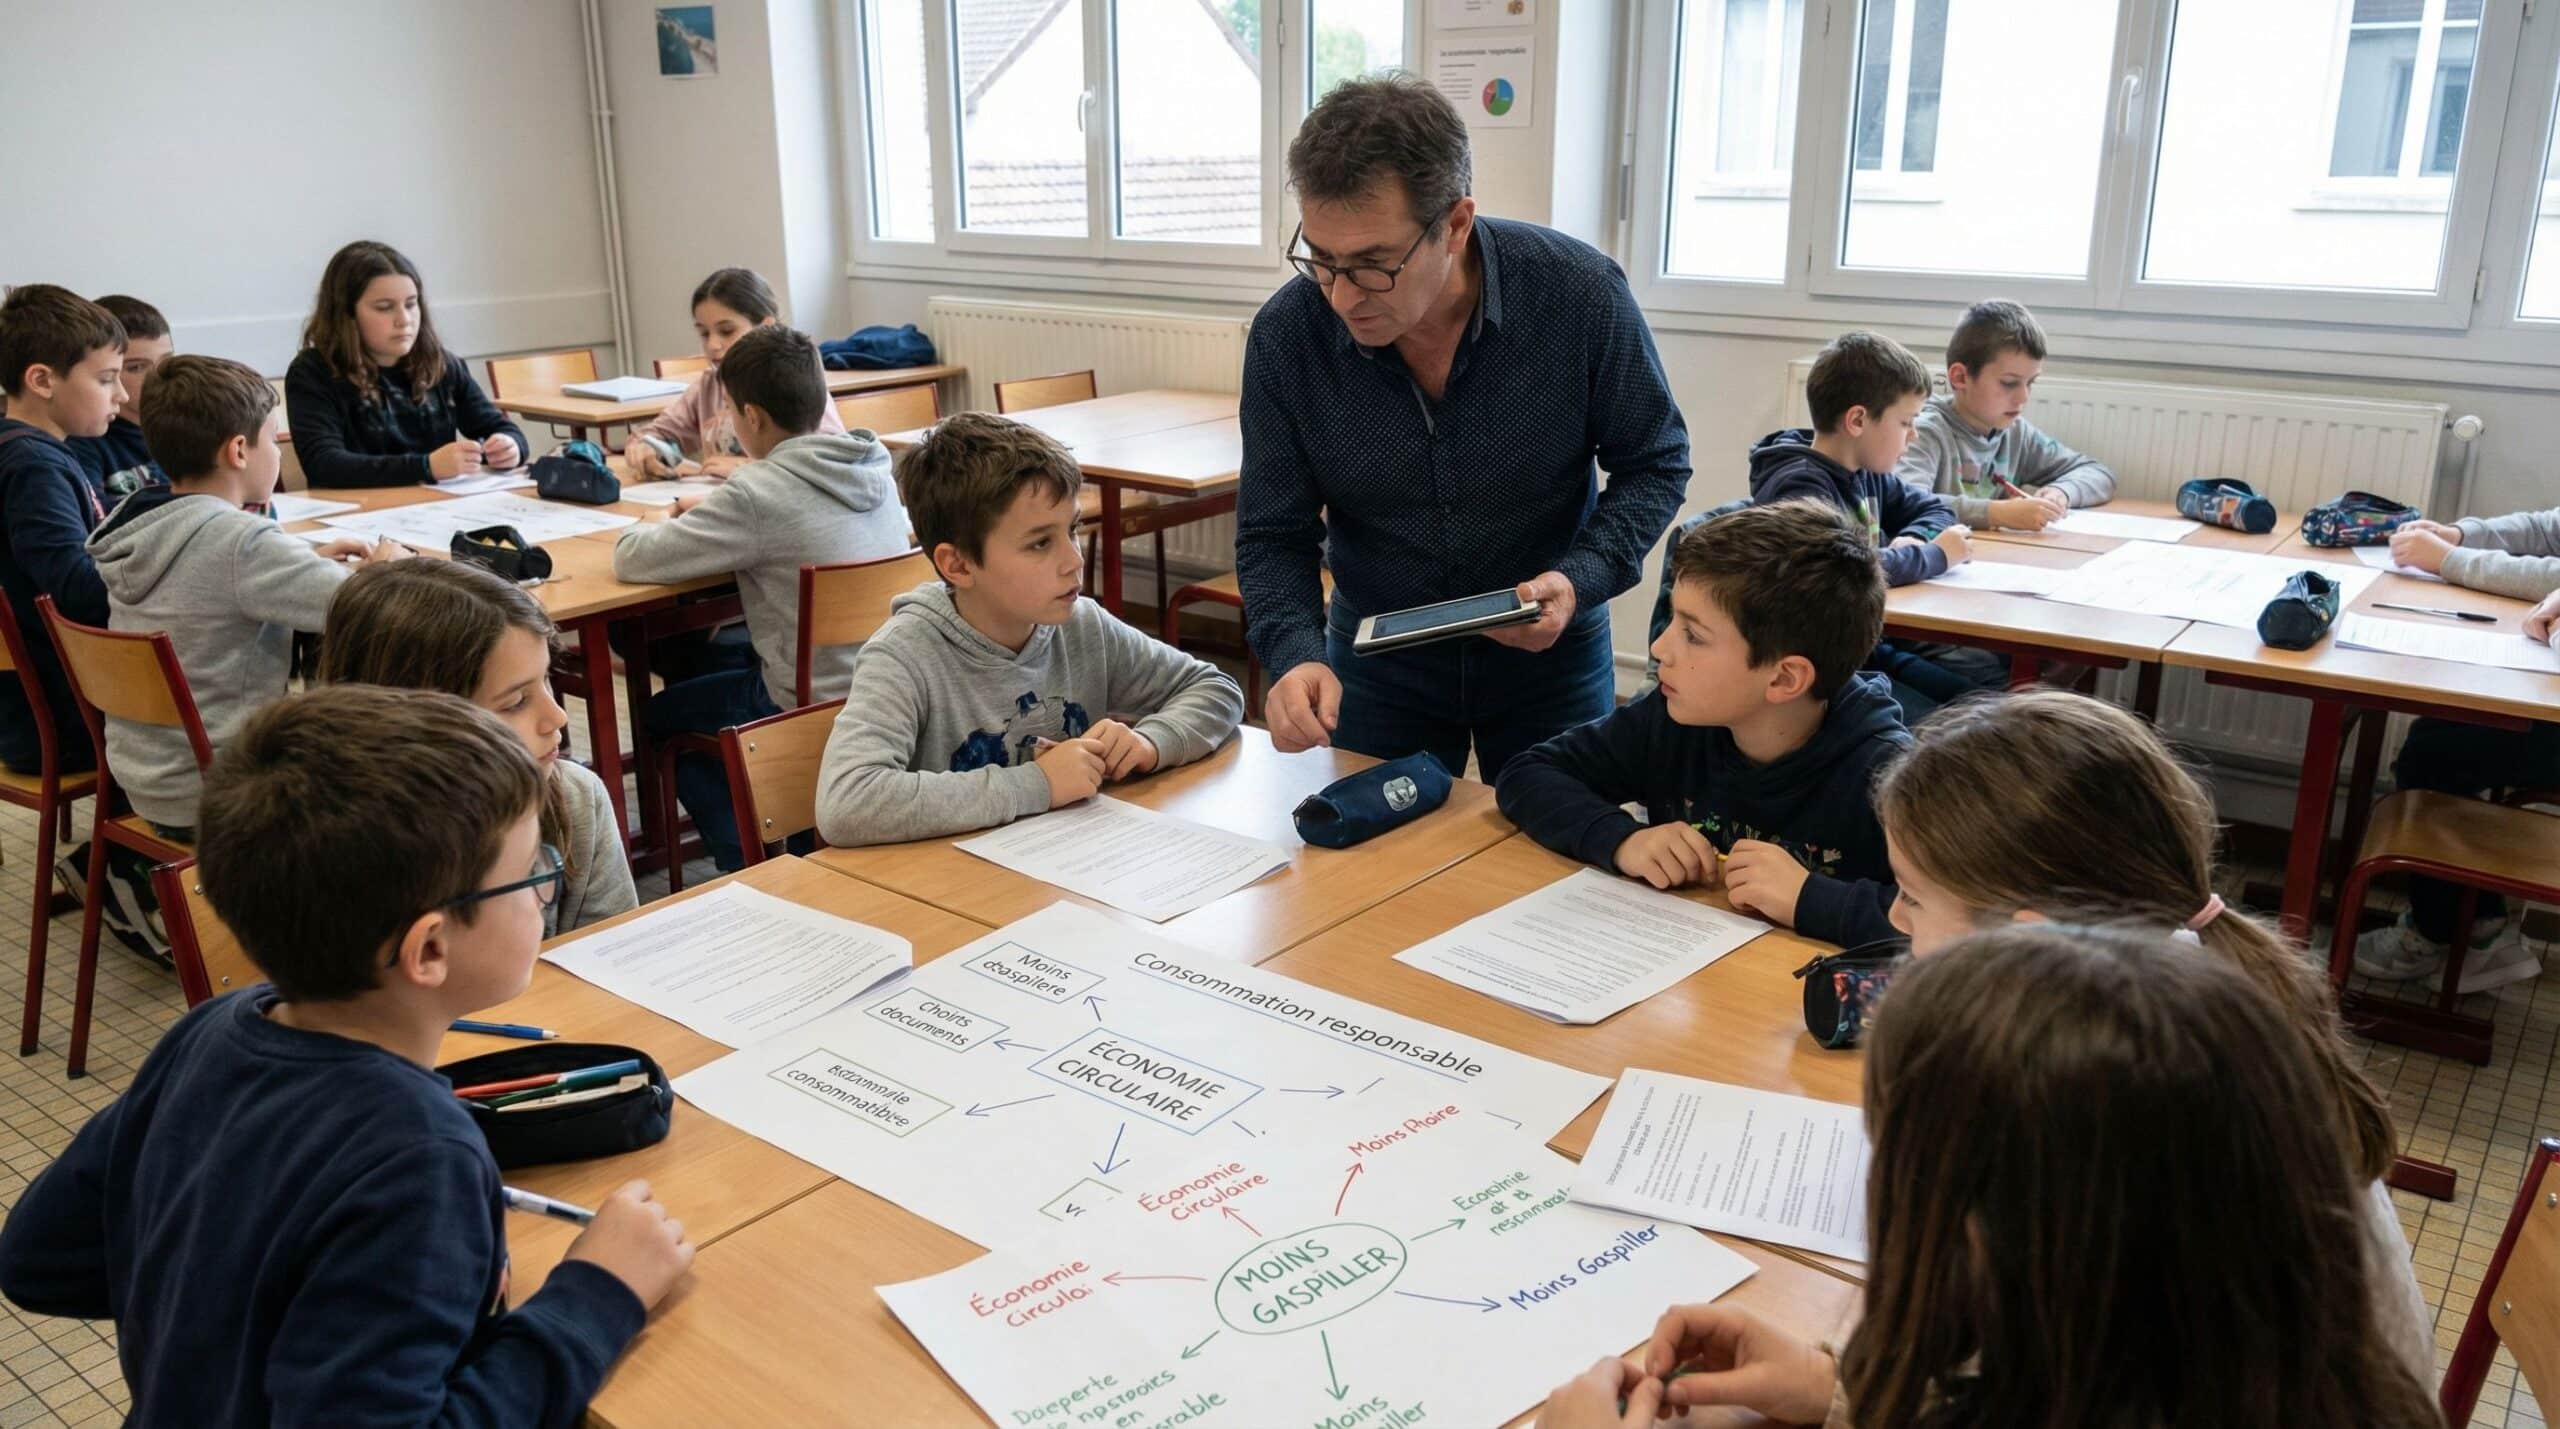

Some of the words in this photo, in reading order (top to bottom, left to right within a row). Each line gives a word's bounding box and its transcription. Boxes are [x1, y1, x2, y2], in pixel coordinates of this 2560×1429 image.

[1017, 954, 1073, 980] Moins
[1133, 952, 1315, 1022] Consommation
[1318, 1014, 1483, 1077] responsable
[1057, 1059, 1202, 1121] CIRCULAIRE
[1088, 1040, 1225, 1099] ÉCONOMIE
[1347, 1130, 1407, 1158] Moins
[1136, 1162, 1246, 1212] Économie
[1171, 1174, 1269, 1221] Circulaire
[970, 1261, 1091, 1317] Économie
[1234, 1239, 1329, 1292] MOINS
[1252, 1247, 1399, 1324] GASPILLER
[1508, 1273, 1577, 1311] Moins
[1577, 1224, 1660, 1275] Gaspiller
